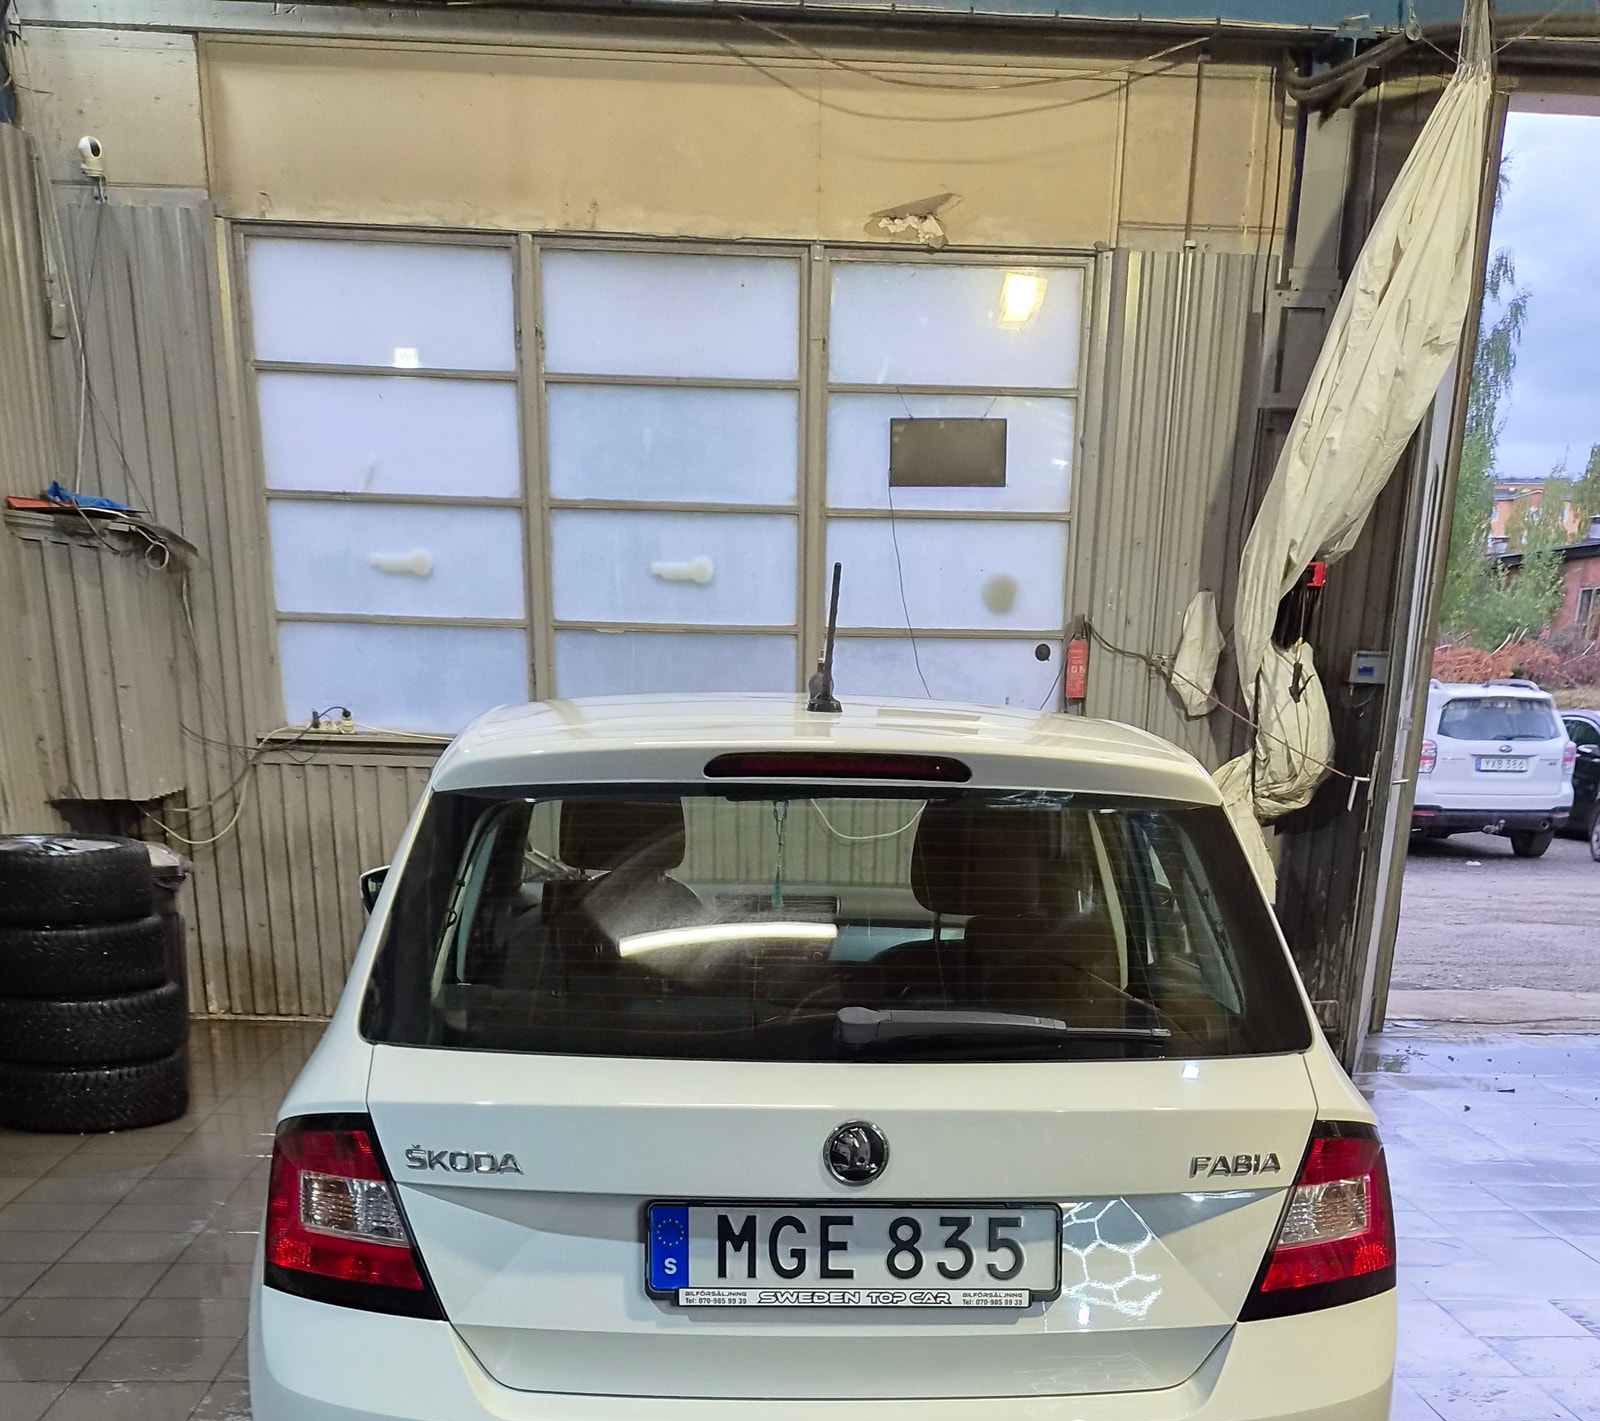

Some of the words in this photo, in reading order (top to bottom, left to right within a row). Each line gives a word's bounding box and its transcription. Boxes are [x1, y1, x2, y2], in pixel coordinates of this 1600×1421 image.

[405, 1144, 524, 1175] ŠKODA
[1189, 1153, 1281, 1178] FABIA
[717, 1214, 855, 1279] MGE
[886, 1216, 1026, 1280] 835
[663, 1257, 678, 1275] S
[757, 1290, 861, 1304] SWEDEN
[866, 1291, 908, 1304] TOP
[909, 1291, 952, 1304] CAR
